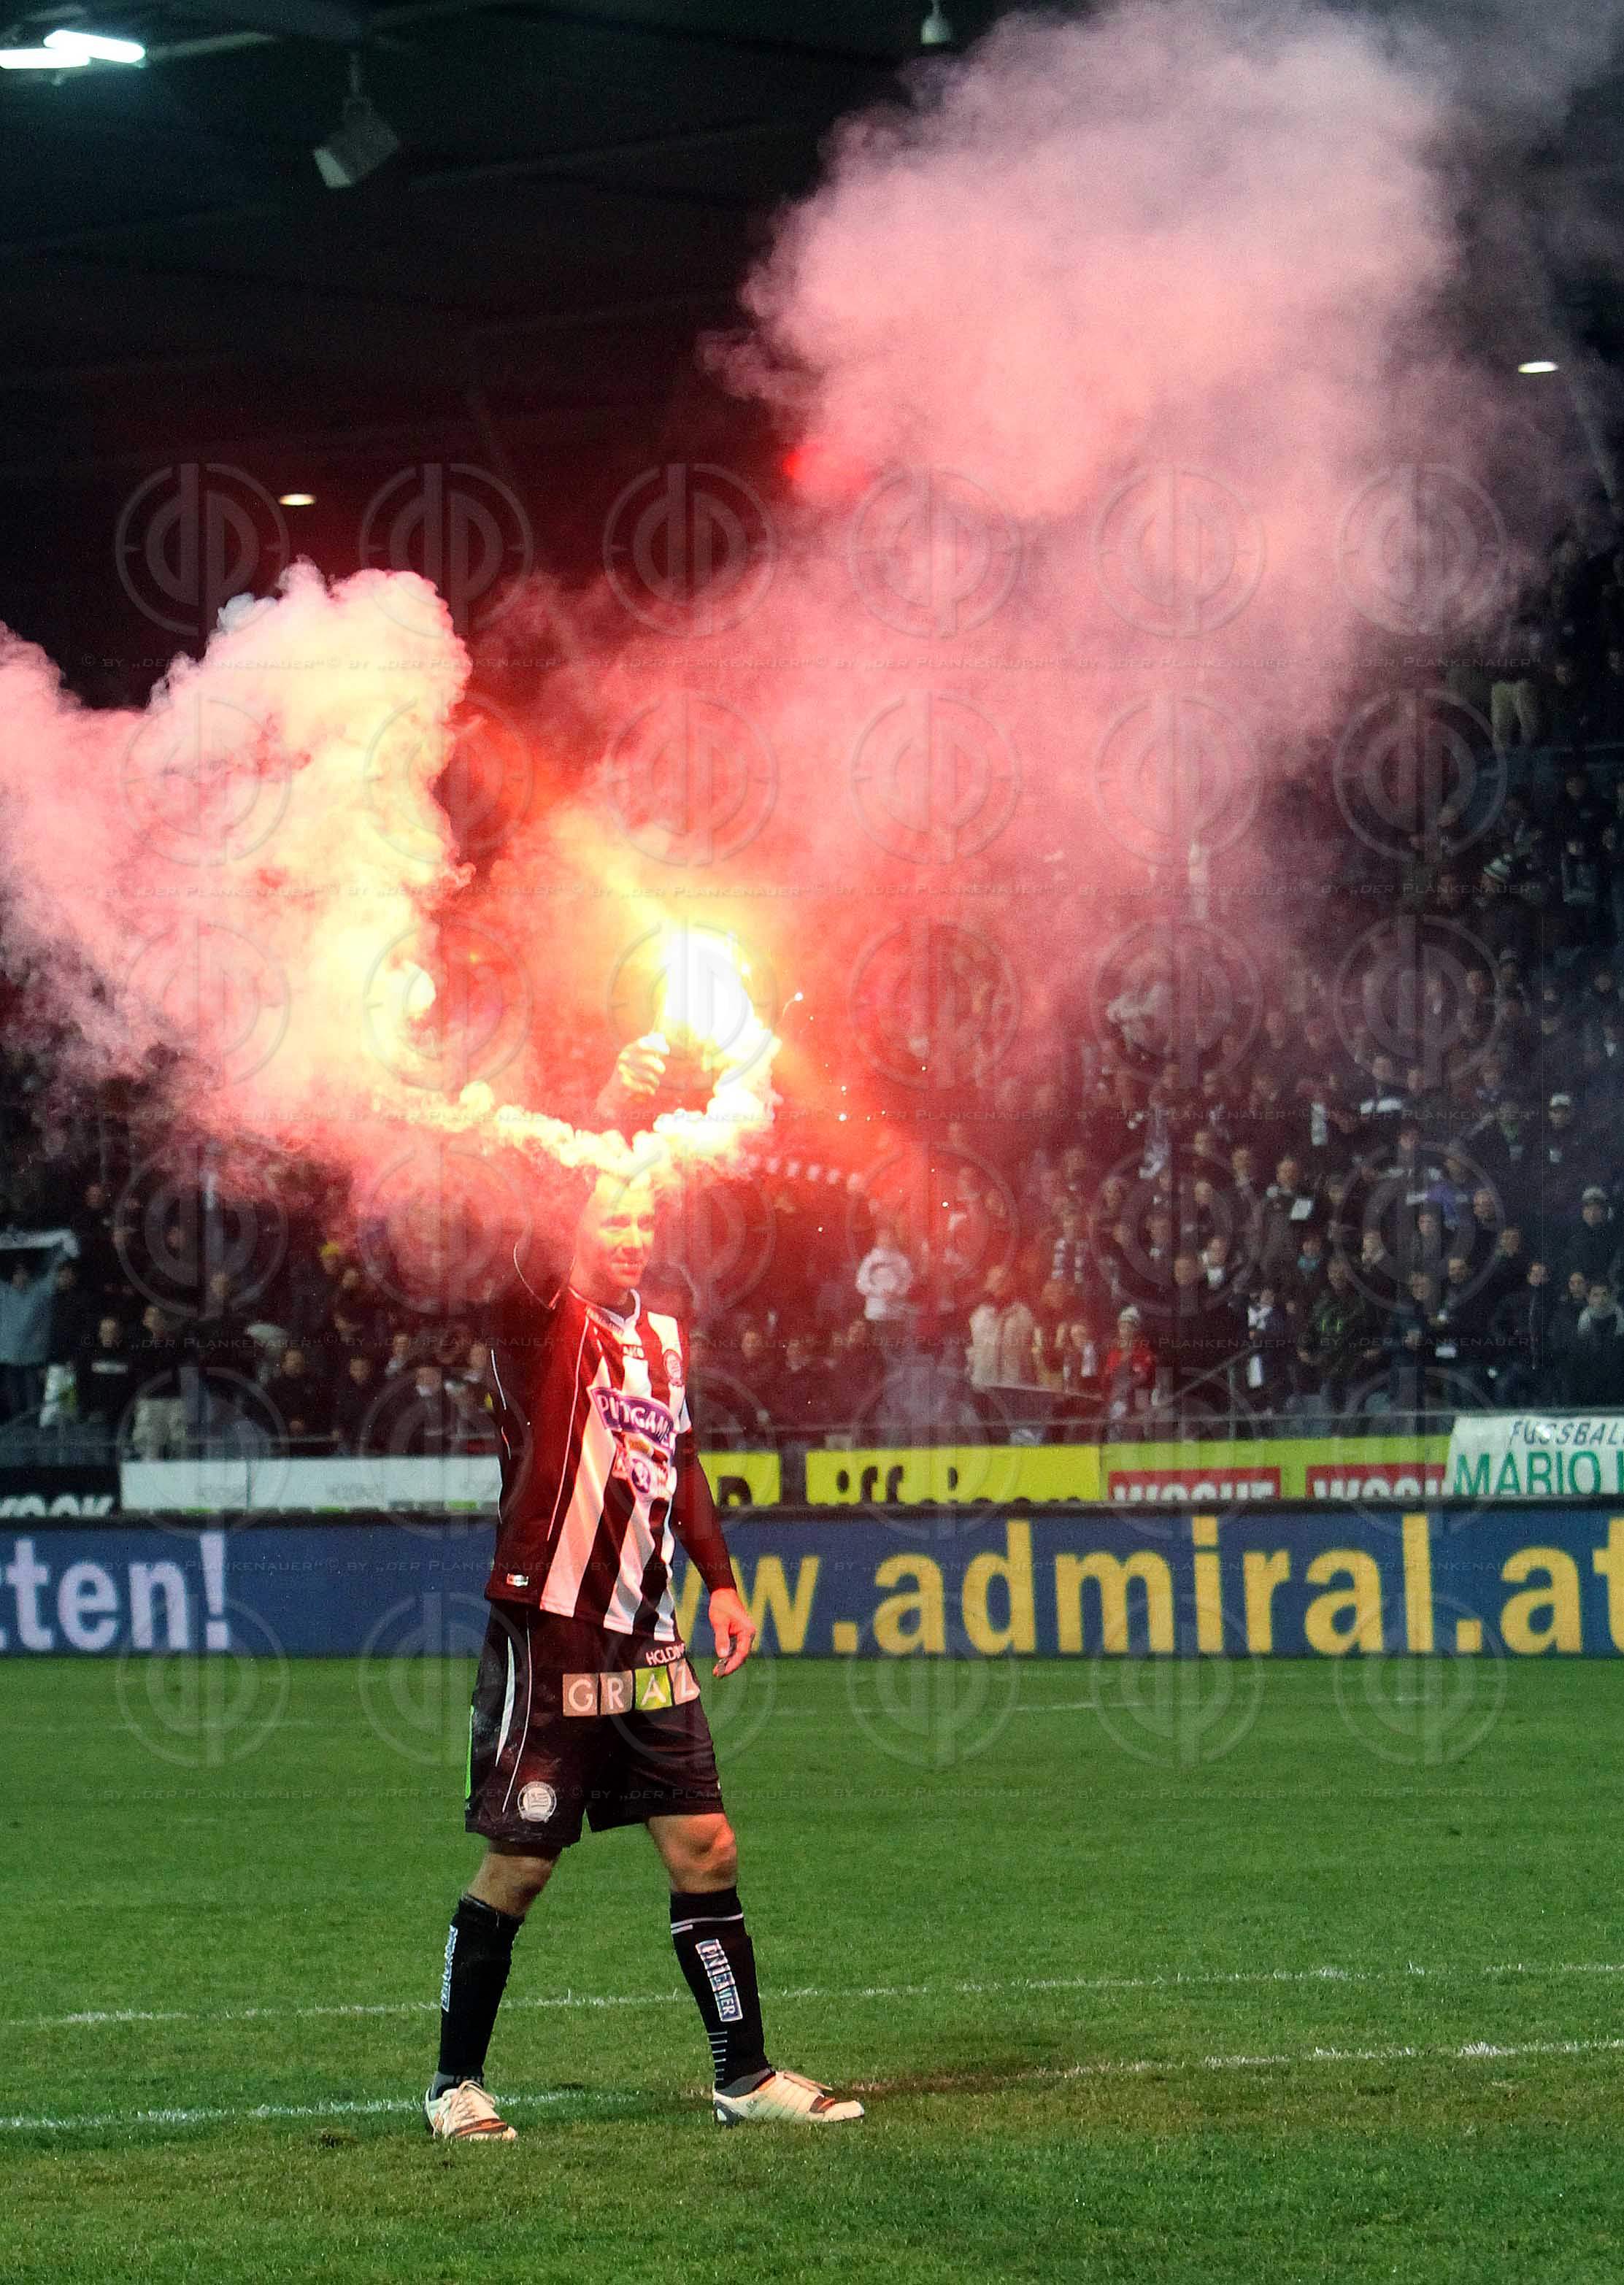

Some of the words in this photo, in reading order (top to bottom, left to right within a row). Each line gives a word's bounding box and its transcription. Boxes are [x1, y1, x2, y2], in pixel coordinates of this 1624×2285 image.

[1509, 1420, 1624, 1445] FUSSBAL
[1454, 1449, 1601, 1495] MARIO
[0, 1531, 231, 1651] ten!
